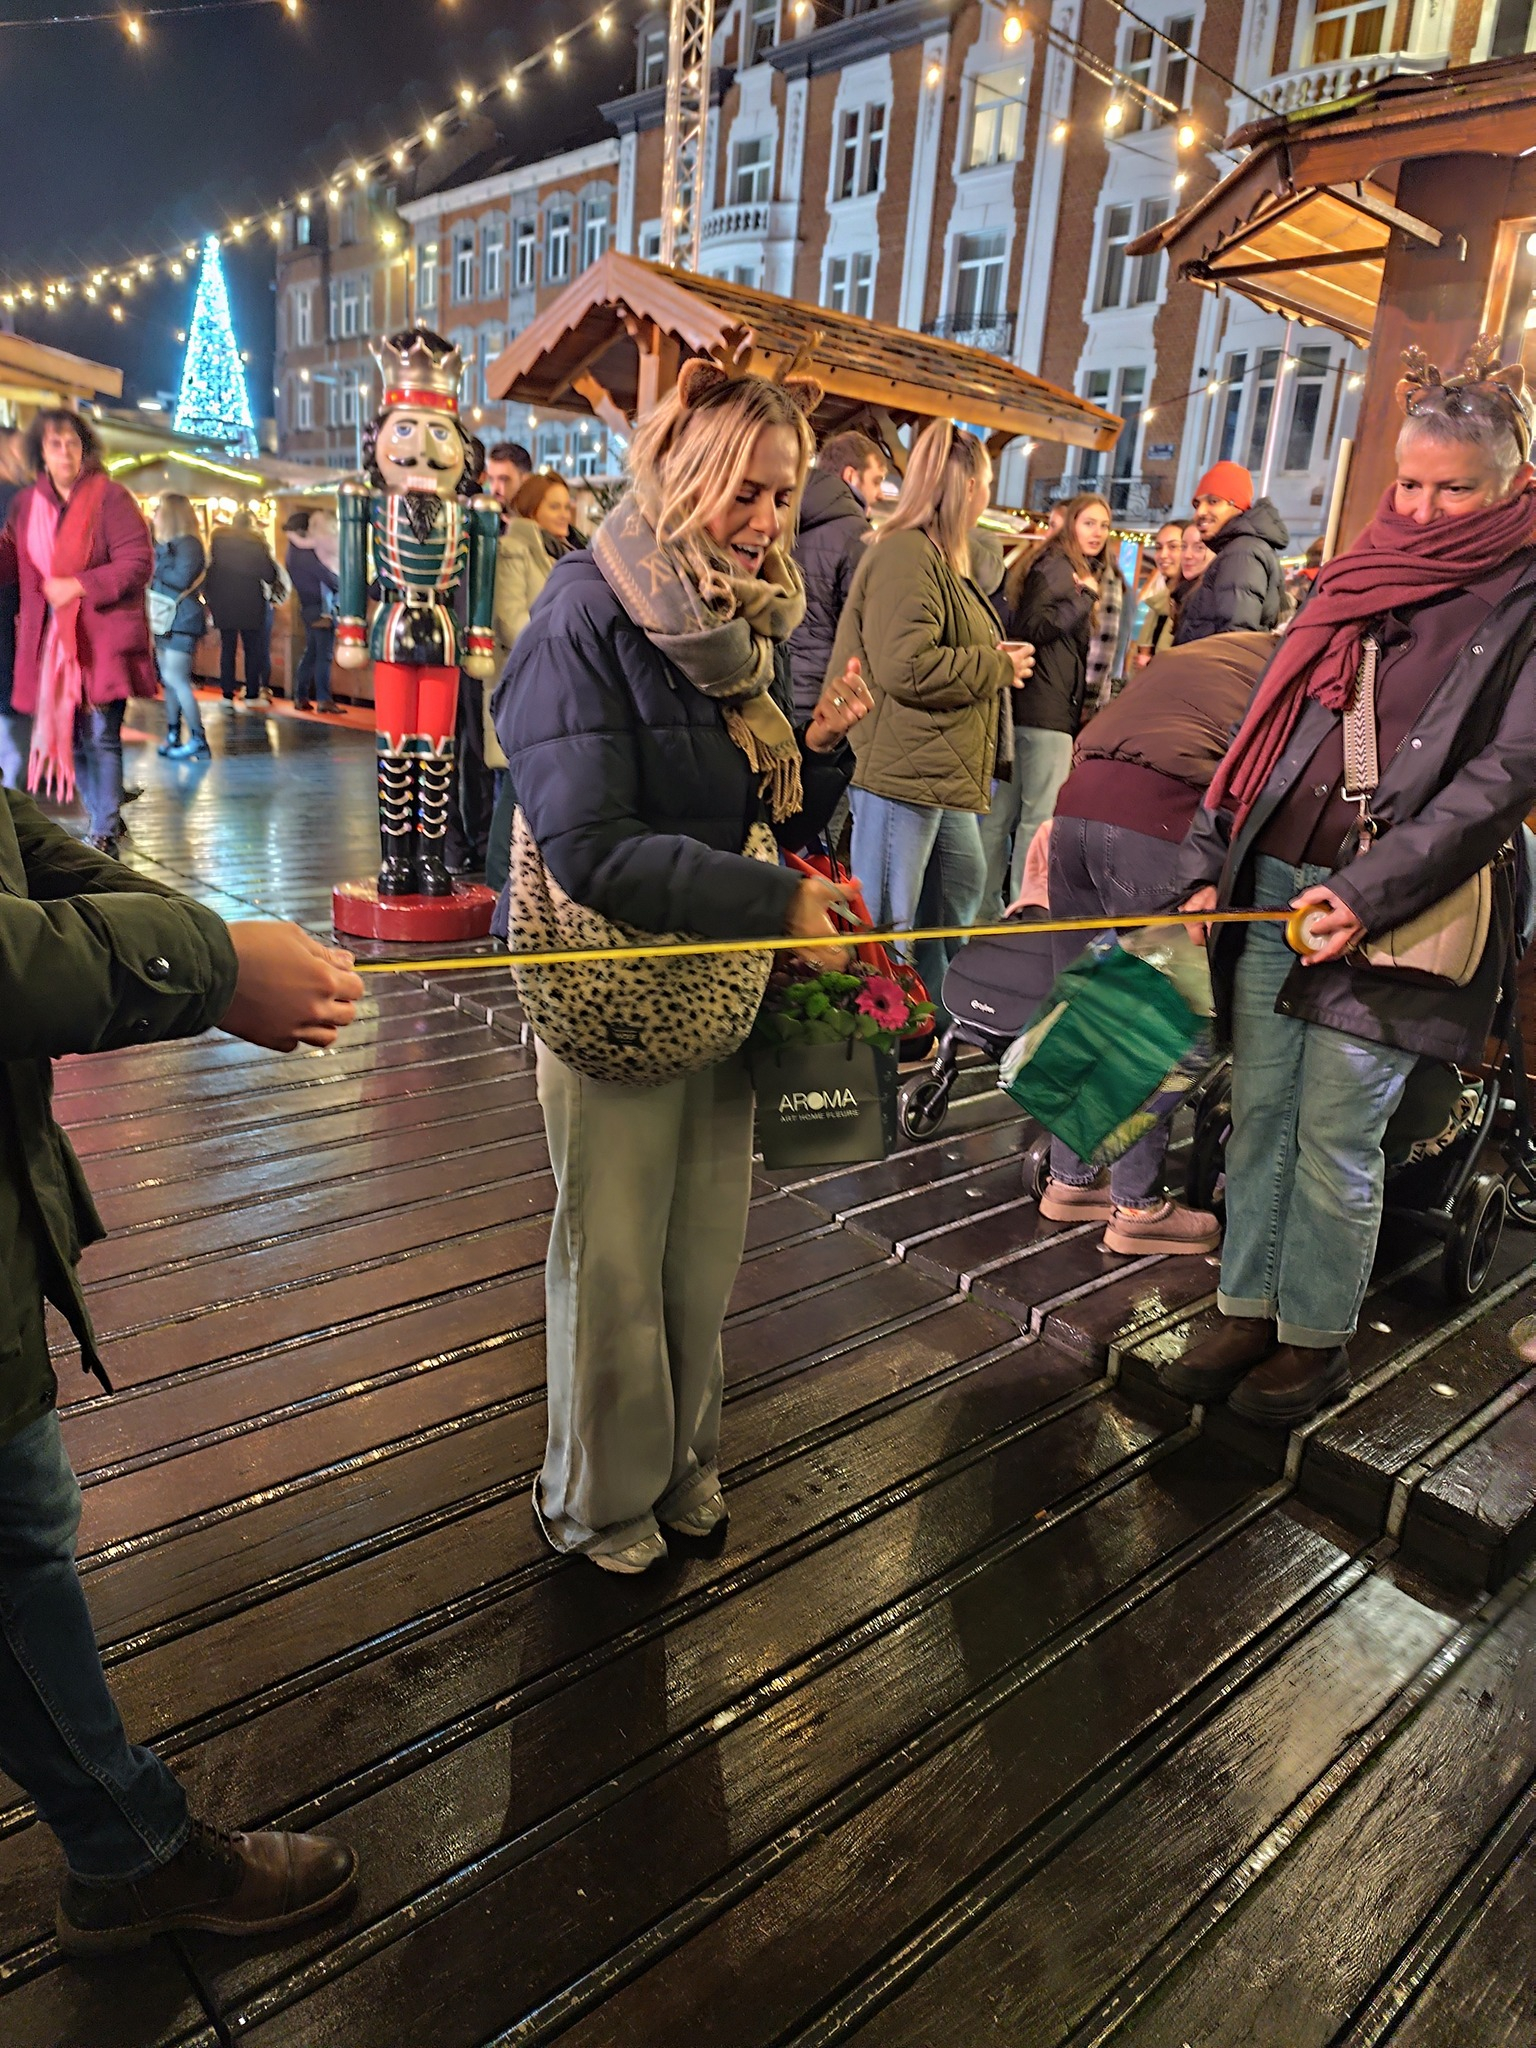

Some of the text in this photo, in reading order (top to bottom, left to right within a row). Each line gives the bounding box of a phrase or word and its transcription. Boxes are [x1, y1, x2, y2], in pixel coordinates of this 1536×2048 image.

[778, 1088, 858, 1113] AROMA
[780, 1114, 798, 1122] ART
[799, 1112, 825, 1120] HOME
